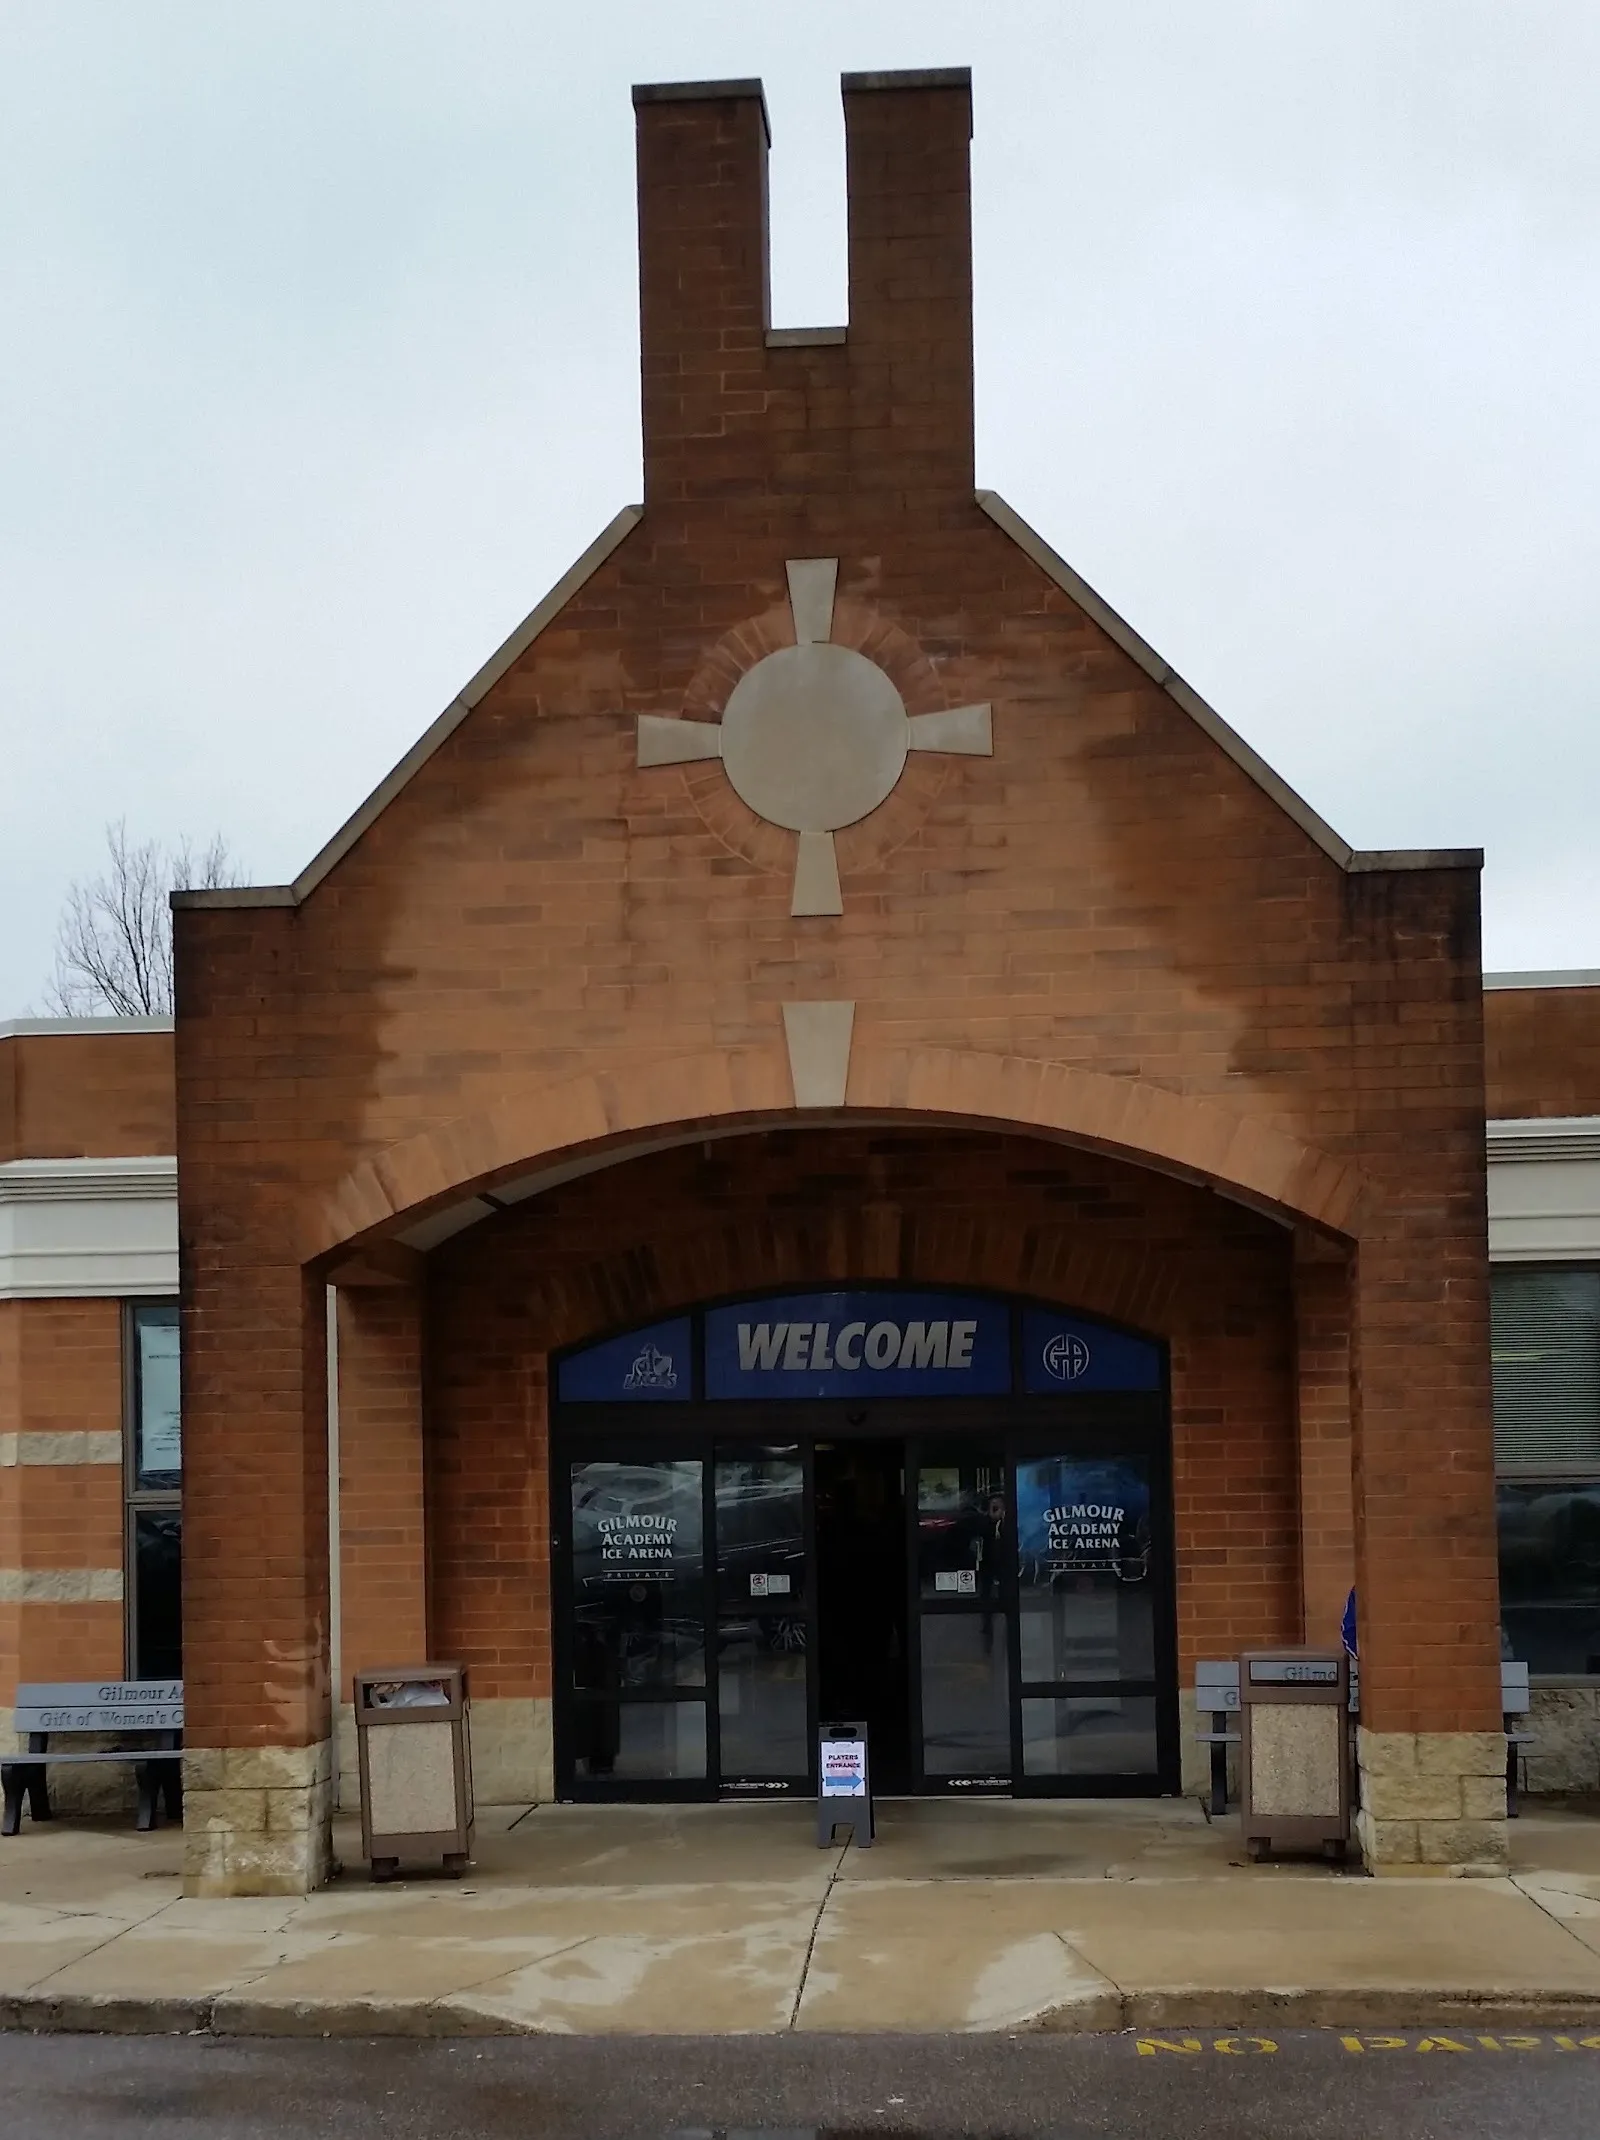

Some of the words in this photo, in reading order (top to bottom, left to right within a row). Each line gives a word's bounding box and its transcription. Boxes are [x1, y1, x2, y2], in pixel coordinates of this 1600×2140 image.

[737, 1320, 977, 1370] WELCOME
[1042, 1504, 1125, 1523] GILMOUR
[597, 1514, 678, 1533] GILMOUR
[1048, 1522, 1121, 1536] ACADEMY
[601, 1533, 673, 1546] ACADEMY
[1048, 1537, 1069, 1550] ICE
[1074, 1537, 1120, 1549] ARENA
[602, 1547, 623, 1560] ICE
[628, 1547, 673, 1559] ARENA
[607, 1571, 670, 1579] PRIVATE
[98, 1686, 165, 1701] Gilmour
[39, 1711, 72, 1727] Gift
[76, 1711, 93, 1726] of
[99, 1709, 167, 1725] Women's
[1135, 2035, 1280, 2056] NO
